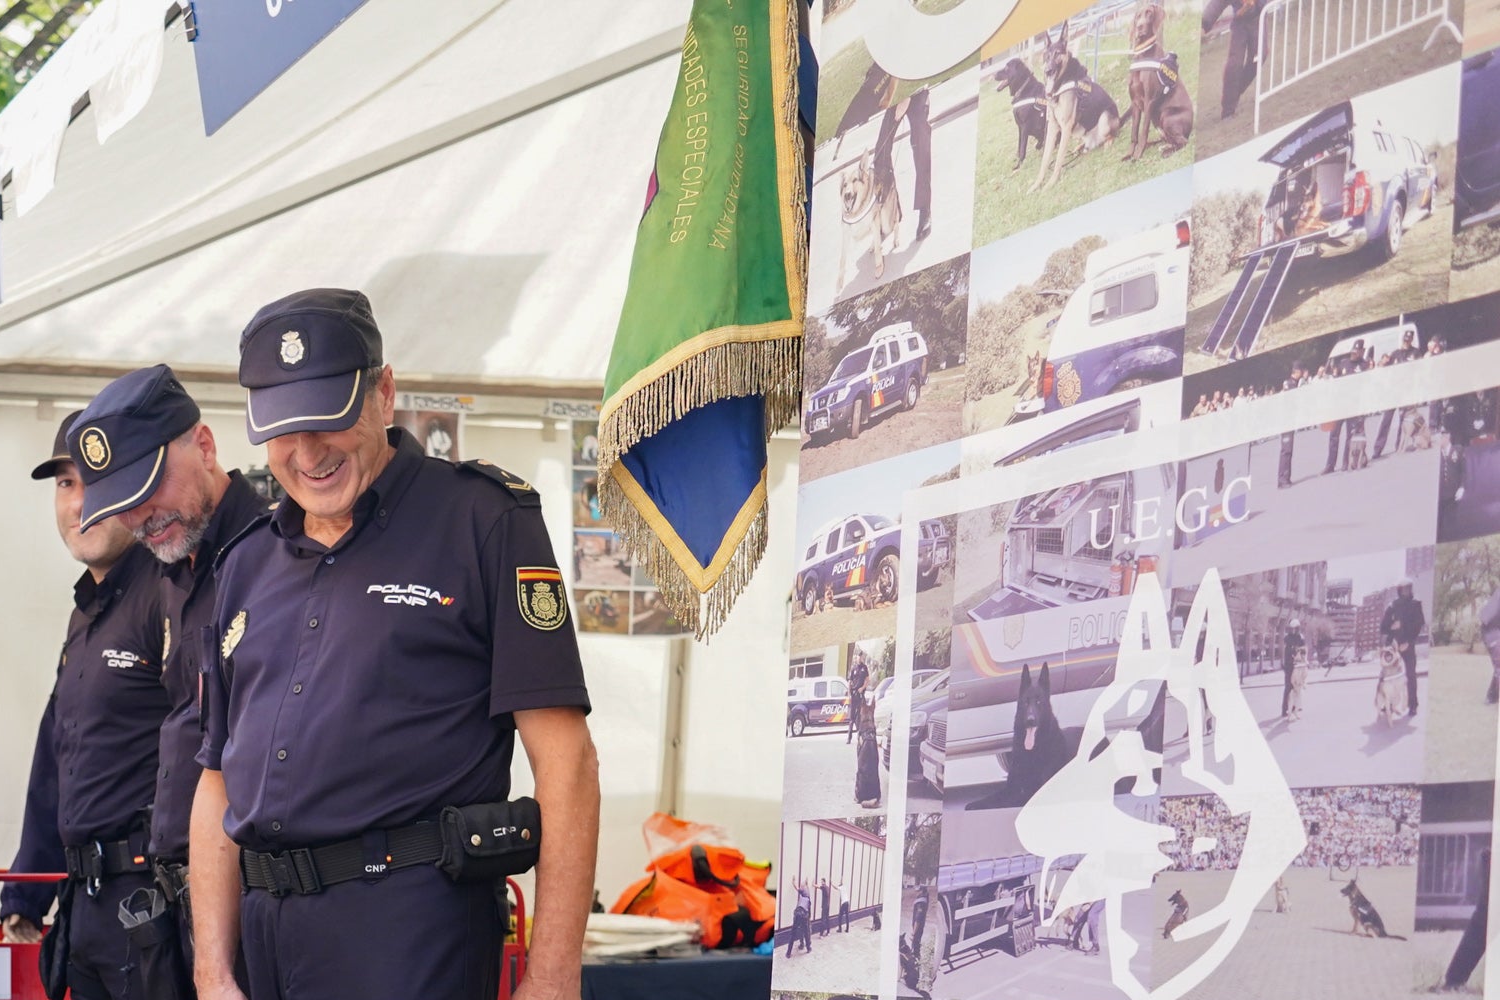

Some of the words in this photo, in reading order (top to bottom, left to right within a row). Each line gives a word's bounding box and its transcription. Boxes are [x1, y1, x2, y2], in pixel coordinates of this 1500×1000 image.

[733, 24, 749, 137] SEGURIDAD
[670, 111, 708, 244] ESPECIALES
[1088, 474, 1252, 550] U.E.G.C
[366, 584, 442, 600] POLICIA
[383, 595, 428, 606] CNP
[1068, 610, 1129, 649] POLIC
[102, 649, 141, 662] POLICIA
[108, 659, 134, 669] CNP
[365, 864, 386, 873] CNP
